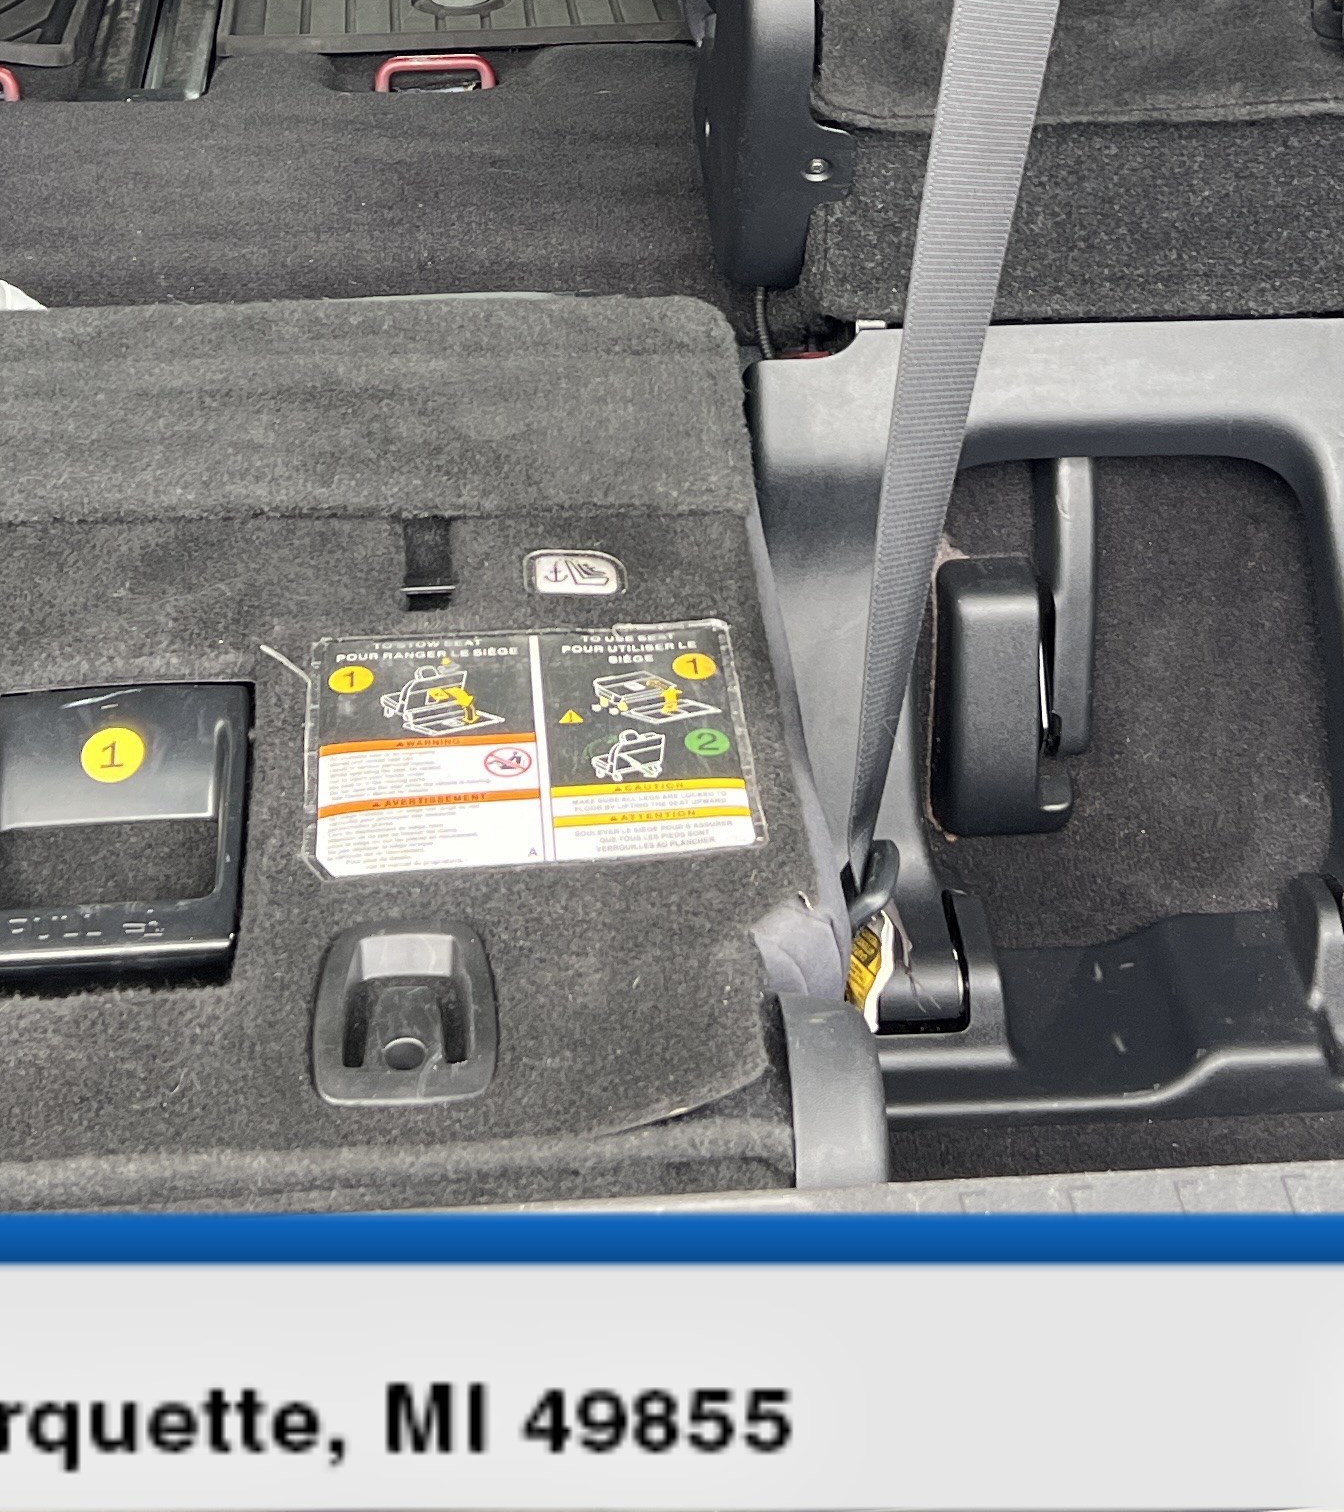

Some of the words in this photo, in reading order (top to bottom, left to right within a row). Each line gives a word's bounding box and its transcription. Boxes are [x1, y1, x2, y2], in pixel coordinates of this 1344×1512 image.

[561, 645, 604, 654] POUR
[607, 641, 675, 653] UTILISER
[677, 640, 697, 649] LE
[335, 652, 379, 663] POUR
[382, 649, 447, 660] RANGER
[450, 648, 469, 658] LE
[697, 732, 719, 751] 2
[99, 740, 125, 770] 1
[623, 781, 684, 792] CAUTION
[619, 809, 696, 822] ATTENTION
